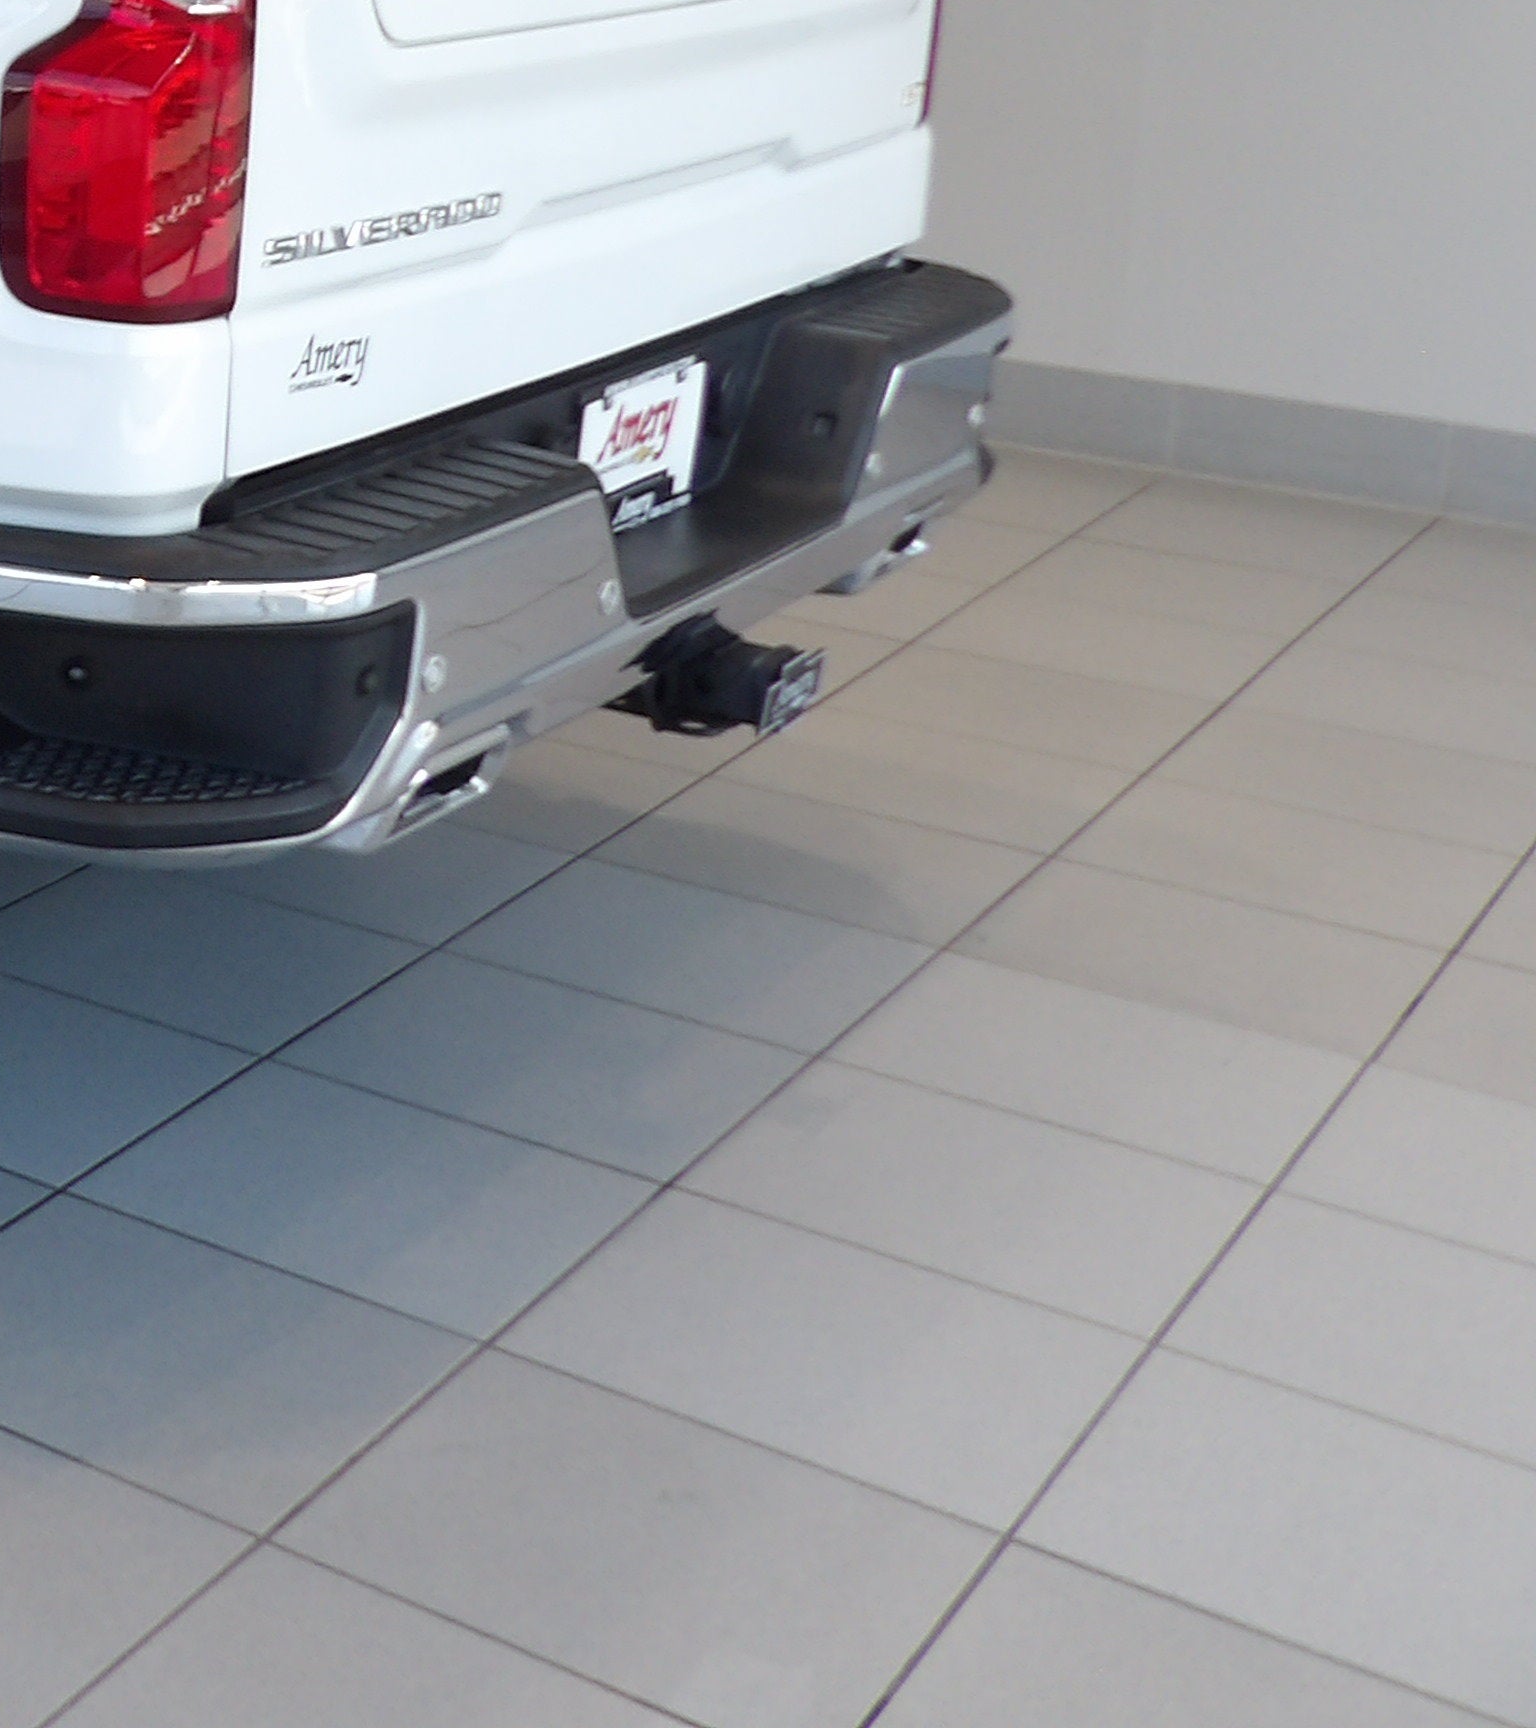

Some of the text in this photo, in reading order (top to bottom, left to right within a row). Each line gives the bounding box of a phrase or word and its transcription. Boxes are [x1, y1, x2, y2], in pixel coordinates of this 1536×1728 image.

[261, 190, 503, 268] SILVERADO
[289, 334, 370, 387] Amery
[596, 397, 678, 462] Amery
